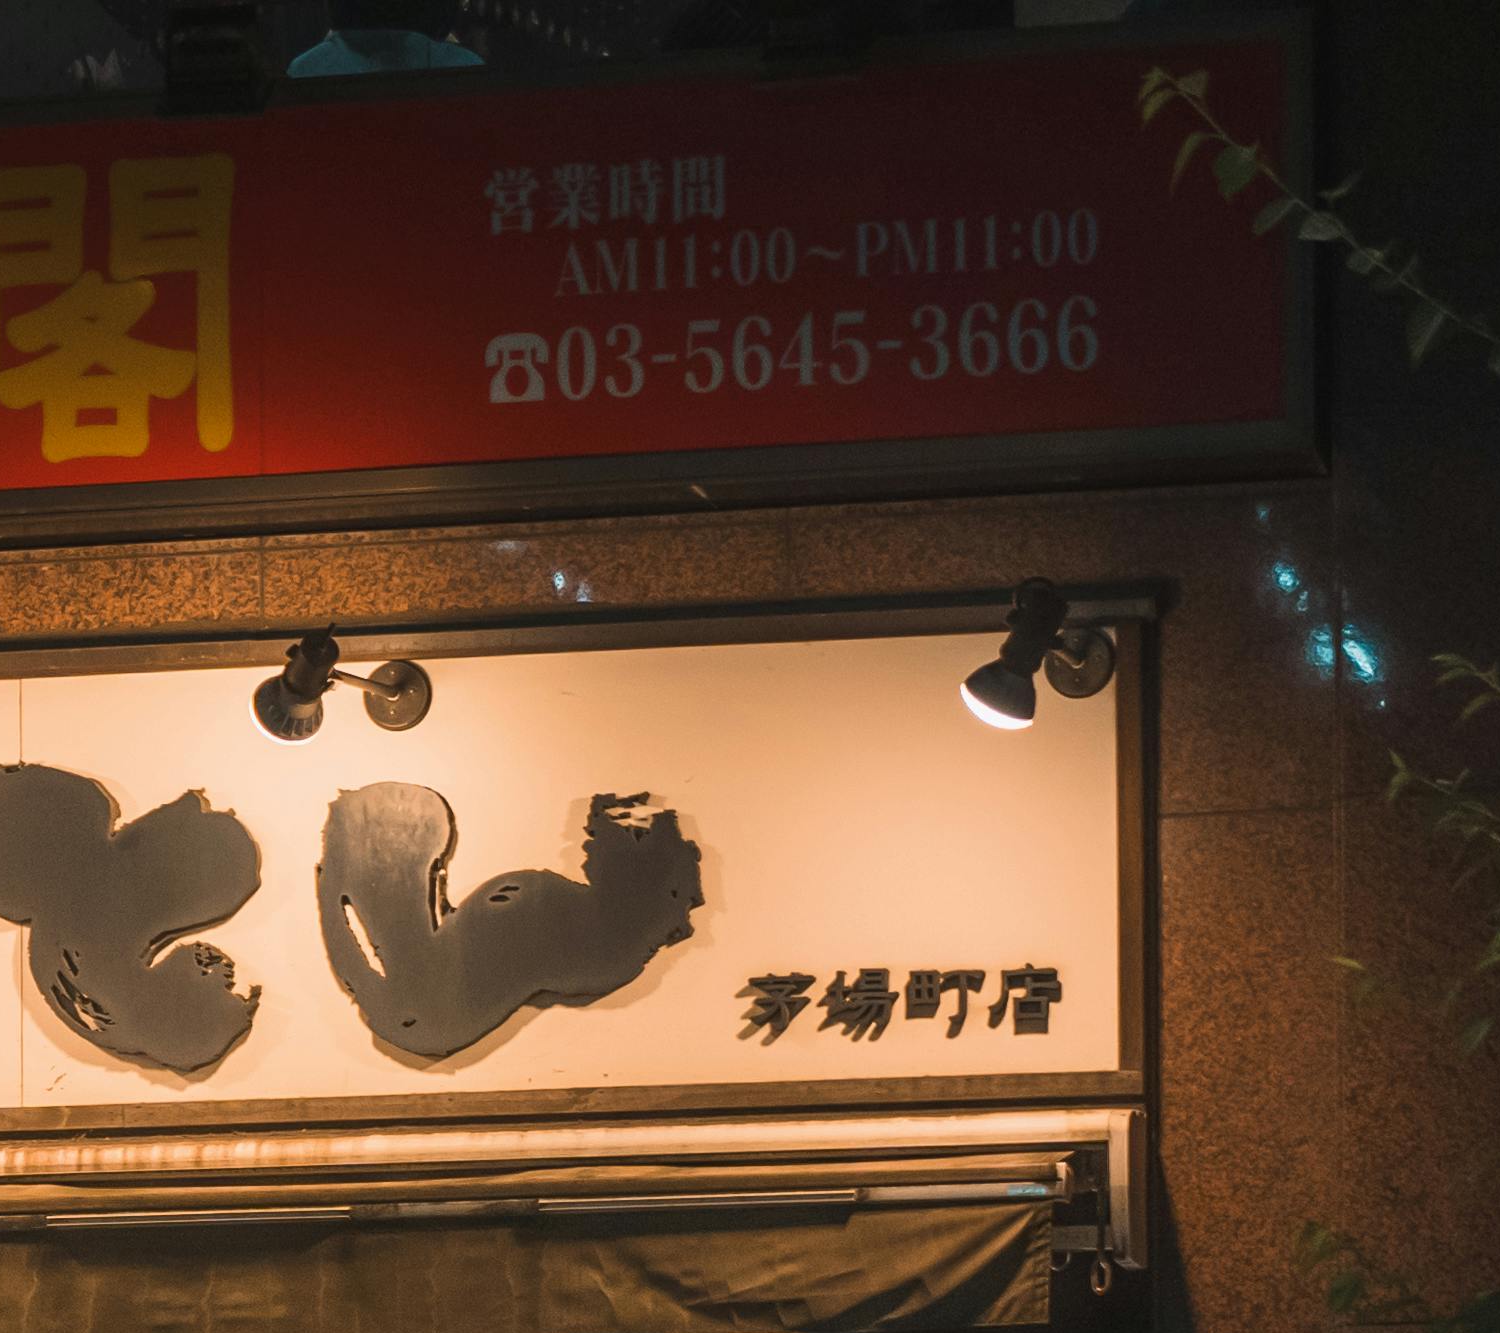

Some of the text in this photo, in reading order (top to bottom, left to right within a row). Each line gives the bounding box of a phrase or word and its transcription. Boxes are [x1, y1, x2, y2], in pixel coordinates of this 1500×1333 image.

[481, 153, 728, 238] 営業時間
[554, 296, 1102, 404] 03-5645-3666
[743, 962, 1064, 1041] 茅場町店
